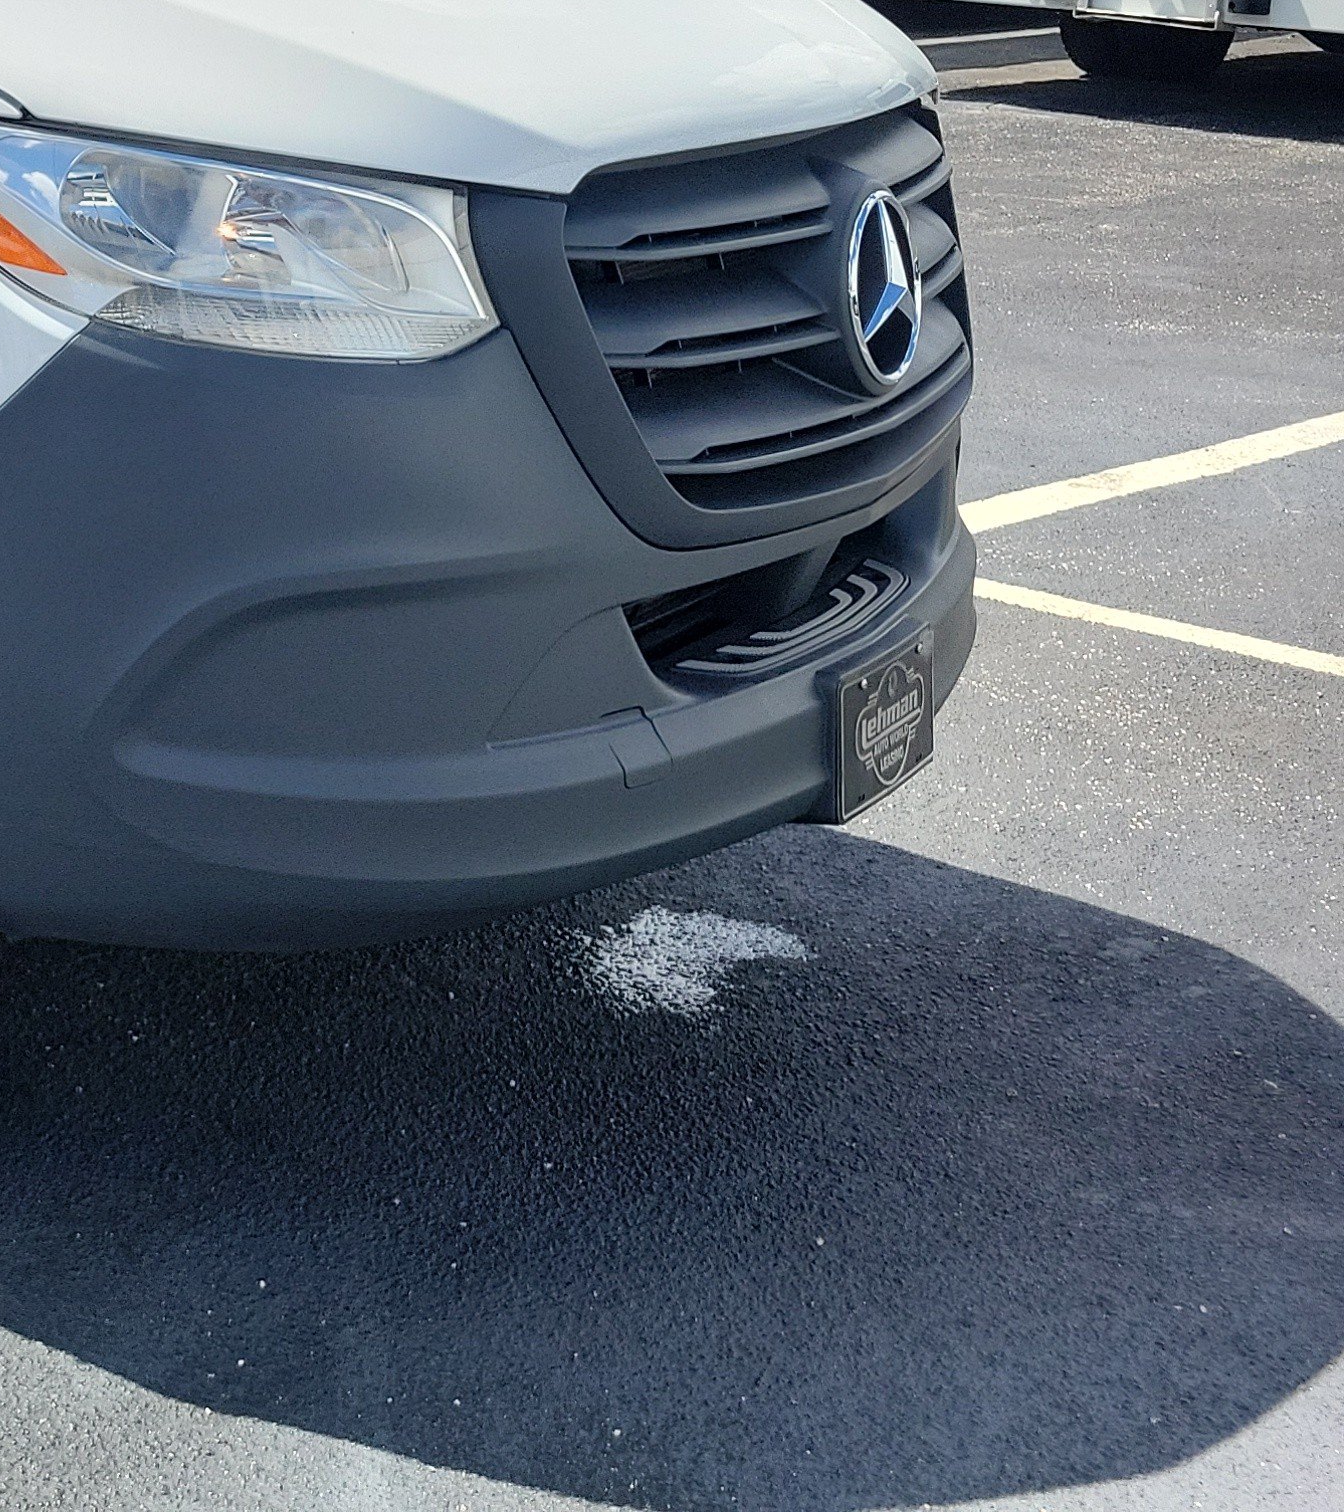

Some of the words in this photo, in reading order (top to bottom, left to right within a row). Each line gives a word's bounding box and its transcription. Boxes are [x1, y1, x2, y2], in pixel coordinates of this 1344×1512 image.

[862, 689, 920, 750] Lehman
[874, 737, 889, 757] AUTO
[889, 723, 909, 747] WORLD
[880, 744, 904, 773] LEASING
